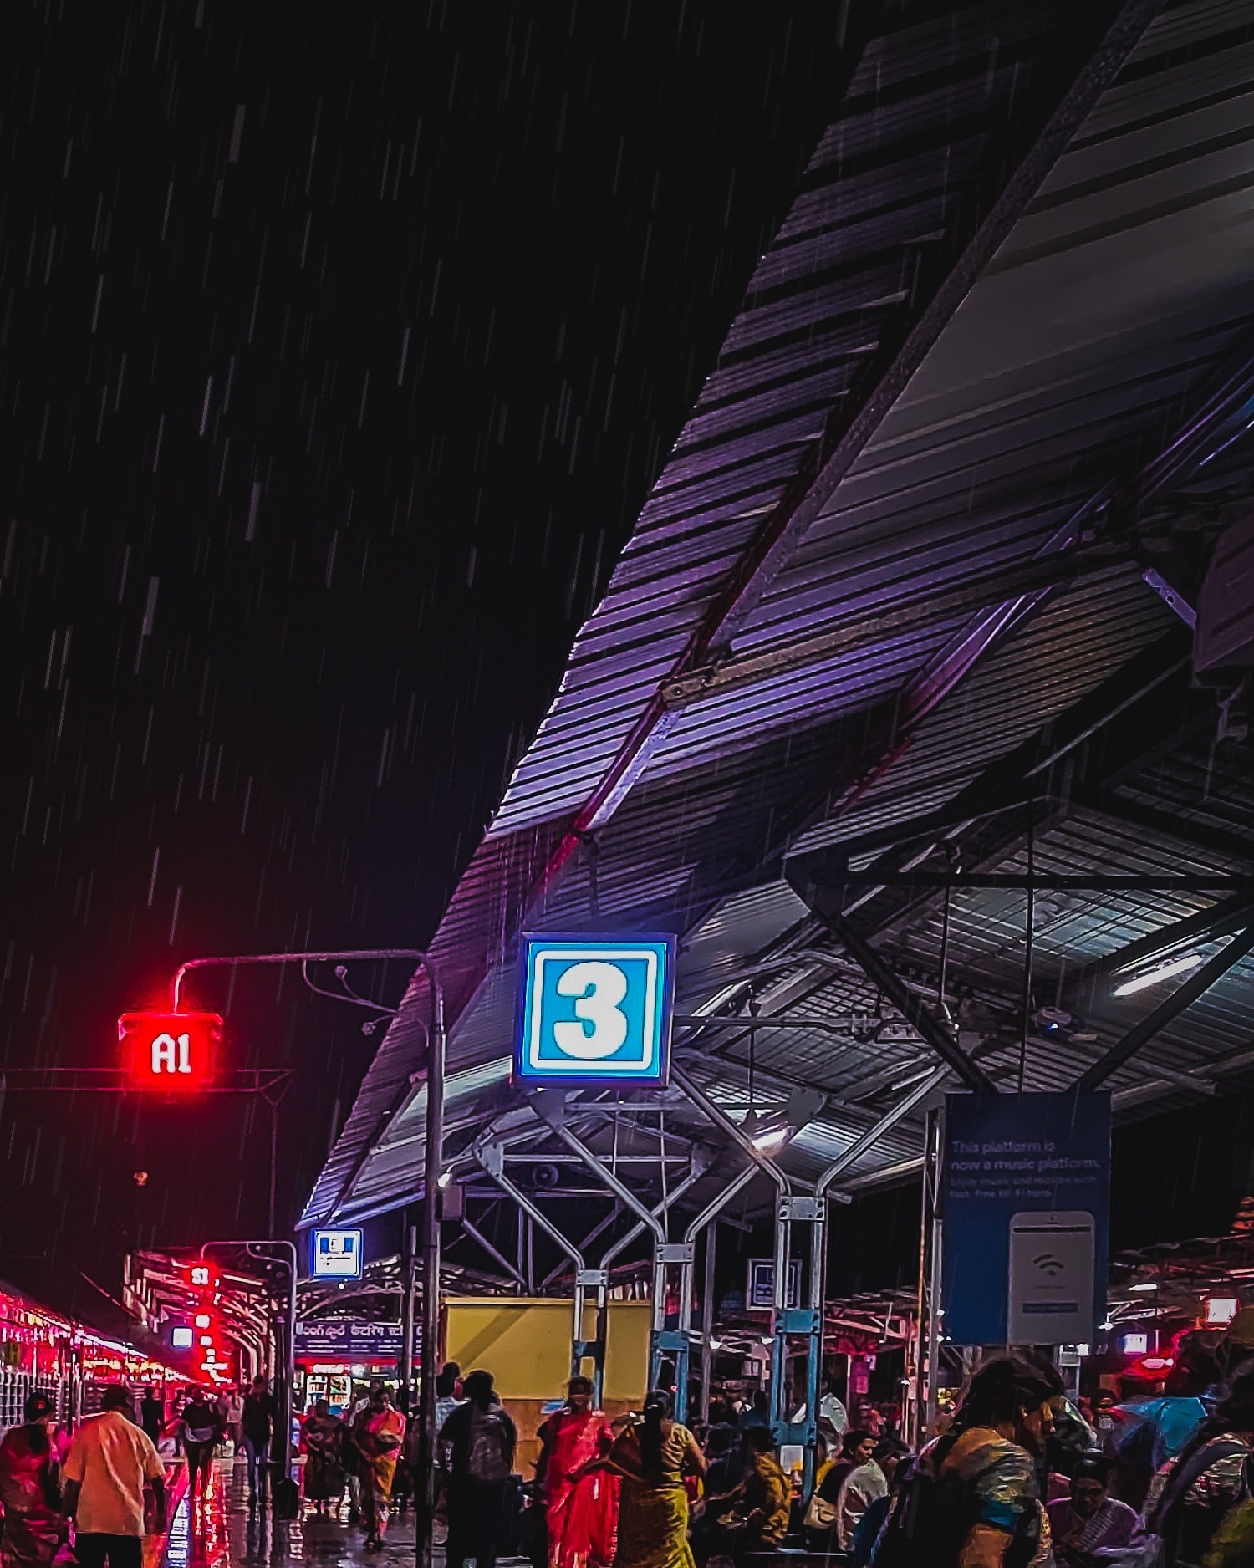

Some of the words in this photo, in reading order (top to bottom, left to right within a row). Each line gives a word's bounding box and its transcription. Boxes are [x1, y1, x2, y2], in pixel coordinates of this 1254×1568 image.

[553, 961, 627, 1059] 3
[150, 1033, 193, 1075] A1
[951, 1140, 979, 1152] This
[982, 1140, 1042, 1155] platform
[950, 1160, 981, 1170] now
[983, 1161, 992, 1170] a
[994, 1157, 1034, 1169] music
